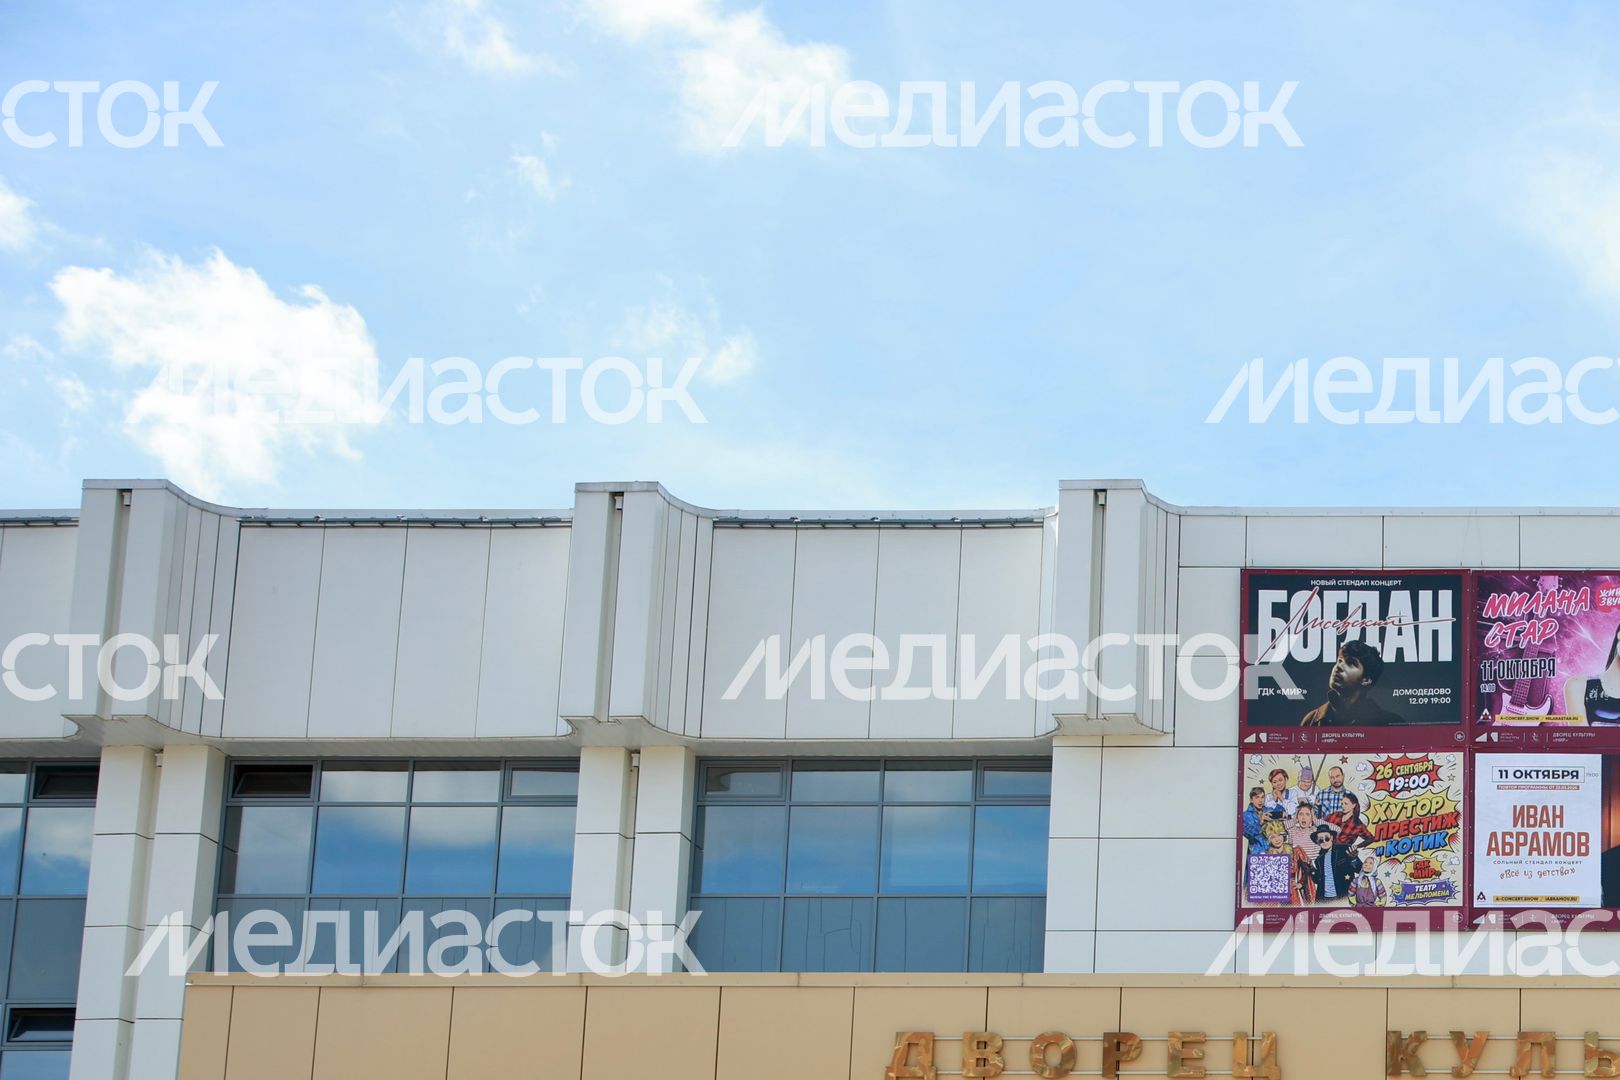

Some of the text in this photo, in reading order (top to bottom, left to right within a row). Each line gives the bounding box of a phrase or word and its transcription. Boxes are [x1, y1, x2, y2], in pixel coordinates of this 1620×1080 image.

[1310, 578, 1336, 586] НОВЫЙ
[1482, 587, 1590, 618] МИЛАНА
[1258, 589, 1452, 663] БОГДАН
[1484, 618, 1559, 648] СТАР
[1481, 657, 1556, 680] 11 ОКТЯБРЯ
[1258, 688, 1308, 696] ГДК «МИР»
[1393, 688, 1451, 697] ДОМОДЕДОВО
[1376, 760, 1434, 780] 26 СЕНТЯБРЯ
[1498, 769, 1579, 779] 11 ОКТЯБРЯ
[1388, 774, 1429, 792] 19:00
[1372, 796, 1445, 824] ХУТОР
[1512, 804, 1564, 828] ИВАН
[1375, 812, 1459, 841] ПРЕСТИЖ
[1385, 831, 1449, 857] КОТИК
[1486, 831, 1590, 856] АБРАМОВ
[1523, 870, 1533, 879] из
[1414, 883, 1437, 892] ТЕАТР
